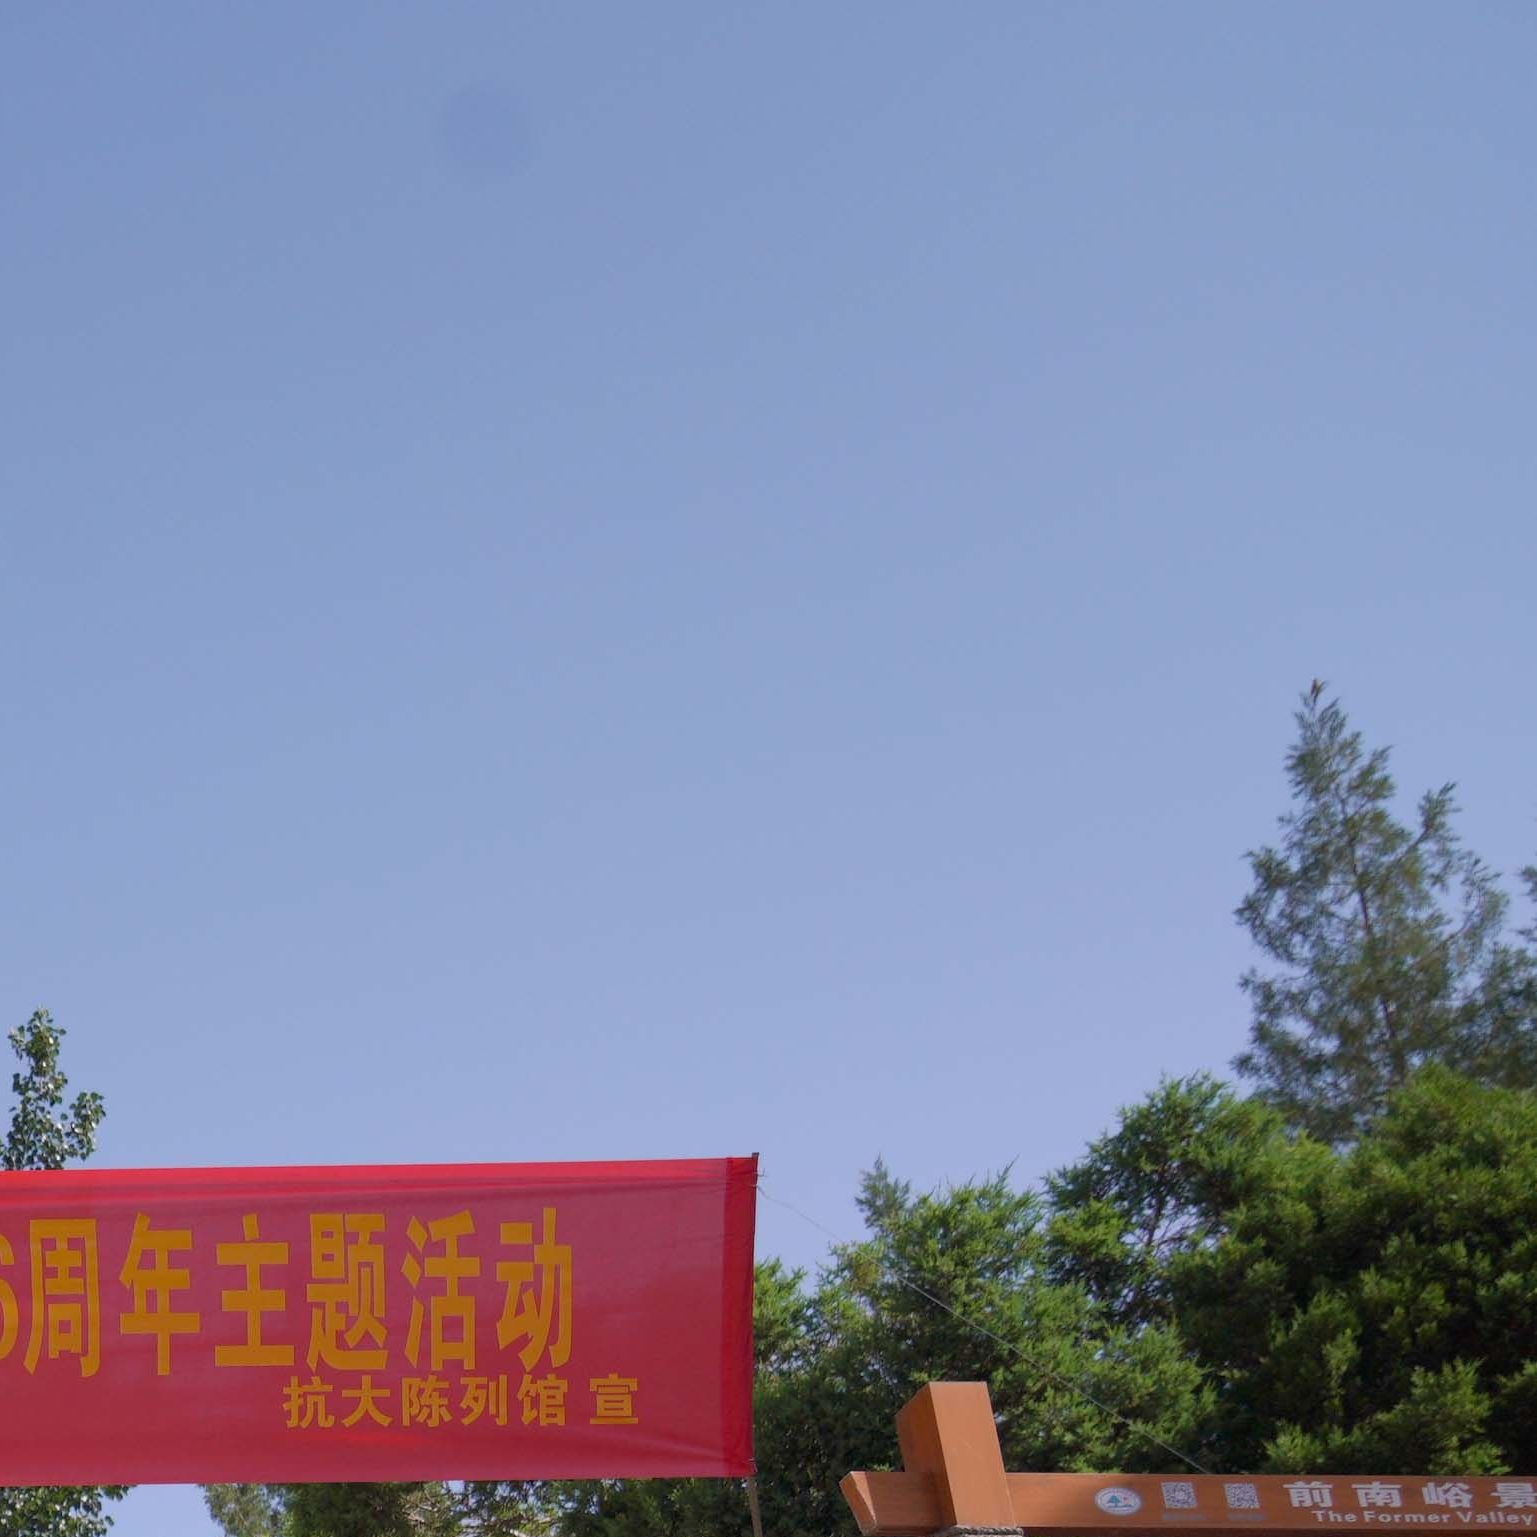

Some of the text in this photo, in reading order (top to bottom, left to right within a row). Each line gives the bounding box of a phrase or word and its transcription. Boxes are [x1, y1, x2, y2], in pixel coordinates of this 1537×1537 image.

[281, 1374, 638, 1428] 抗大陈列馆 宣
[1311, 1510, 1534, 1526] The Former Valley
